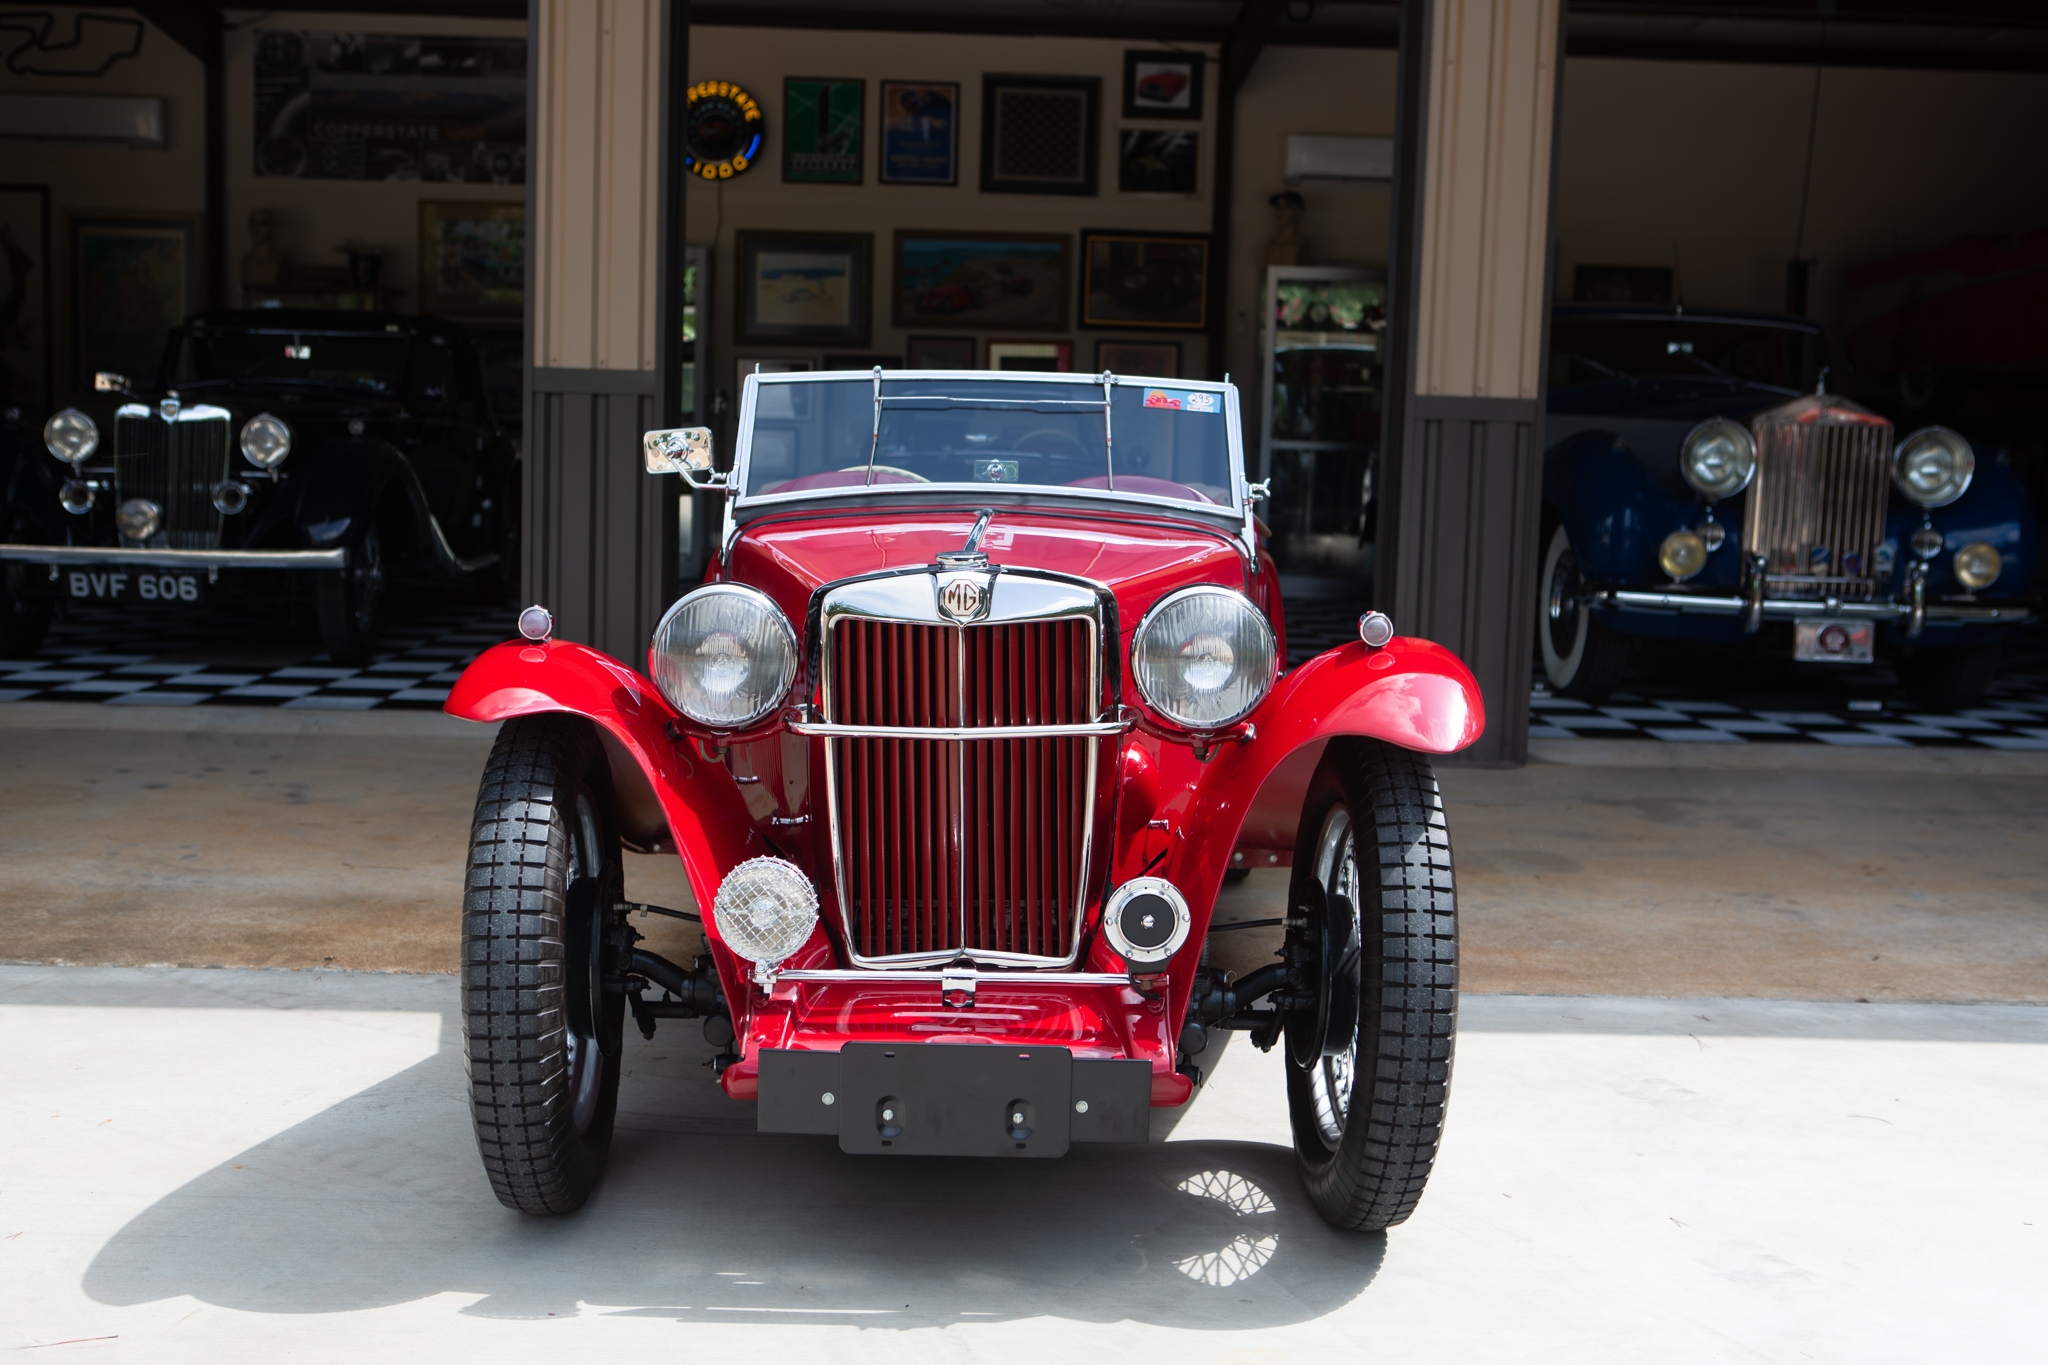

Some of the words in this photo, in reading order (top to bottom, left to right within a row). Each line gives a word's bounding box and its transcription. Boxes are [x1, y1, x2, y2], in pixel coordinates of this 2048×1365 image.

[312, 121, 441, 141] COPPERSTATE
[693, 155, 749, 180] 1000
[1191, 393, 1211, 404] 295
[69, 572, 128, 598] BVF
[138, 574, 198, 601] 606
[948, 583, 977, 611] MG
